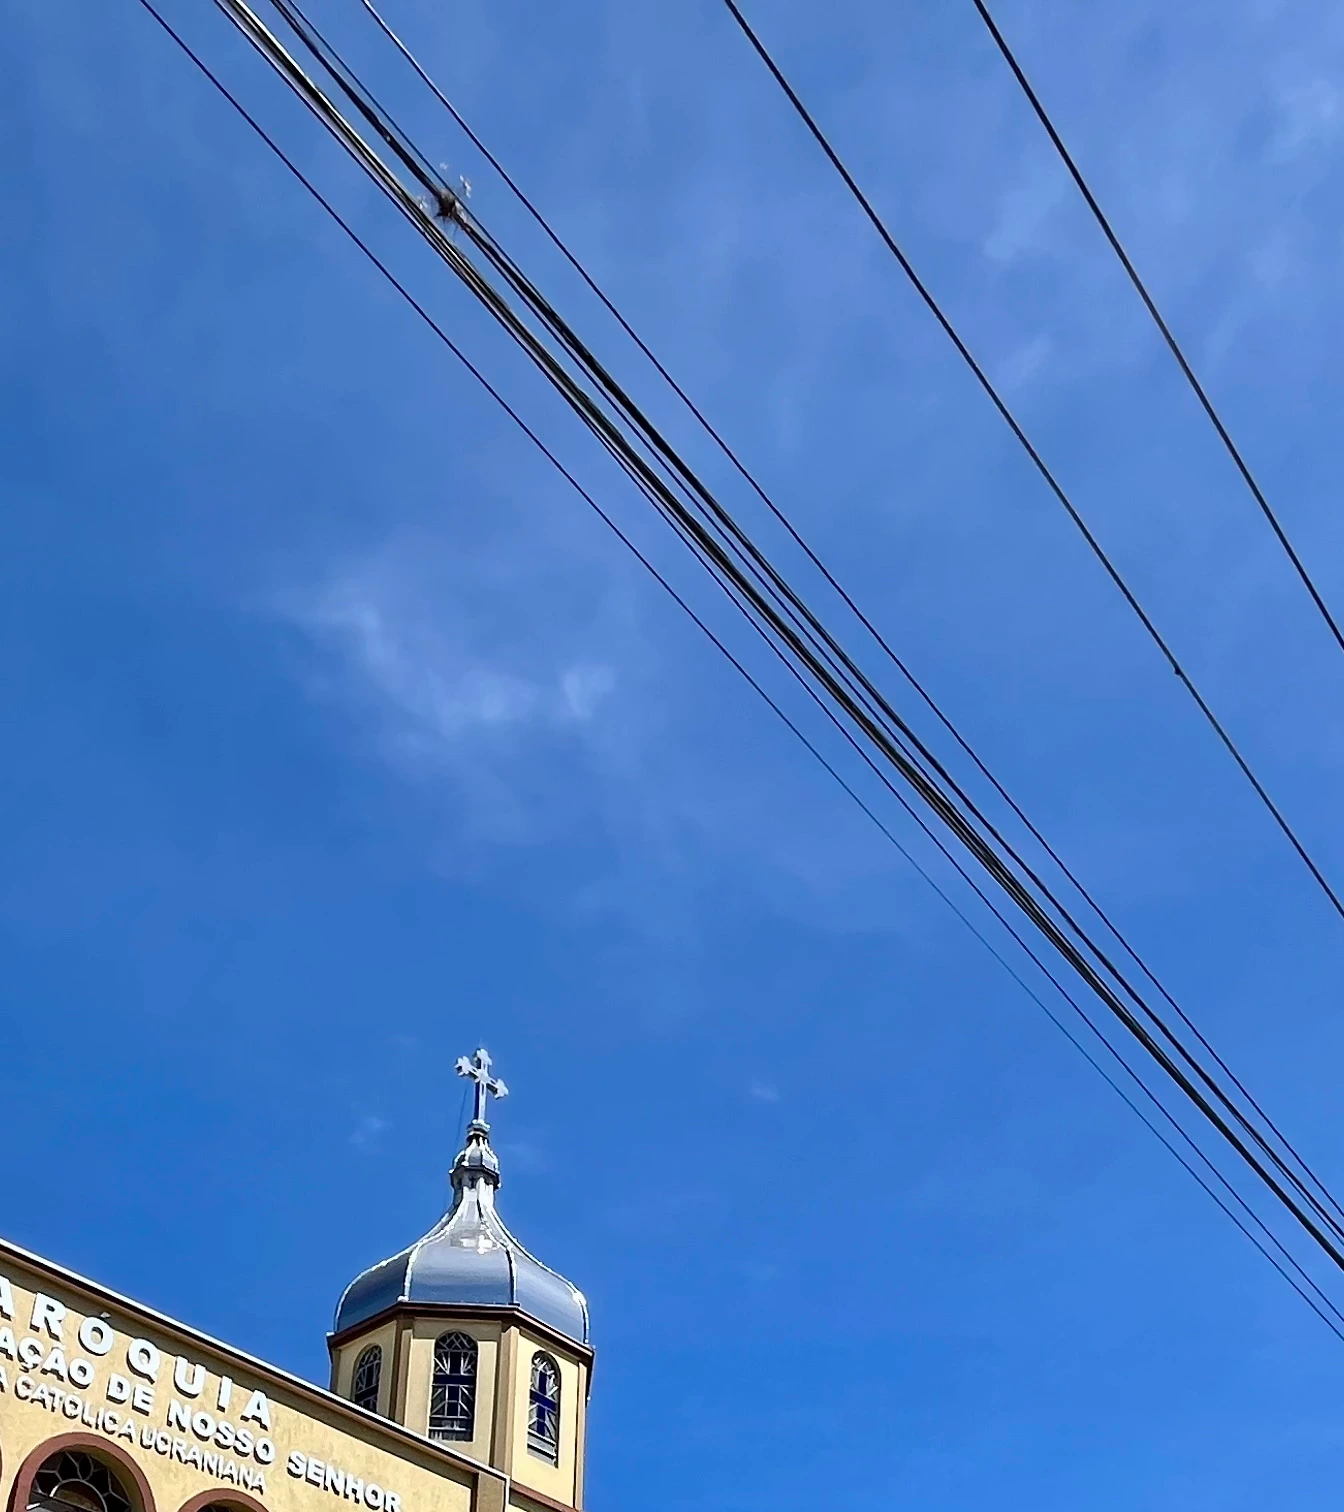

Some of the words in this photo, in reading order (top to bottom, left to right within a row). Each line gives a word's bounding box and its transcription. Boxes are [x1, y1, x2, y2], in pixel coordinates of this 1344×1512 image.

[14, 1375, 137, 1443] CATÓLICA
[140, 1425, 267, 1495] UCRANIANA
[106, 1372, 155, 1416] DE
[167, 1399, 276, 1465] NOSSO
